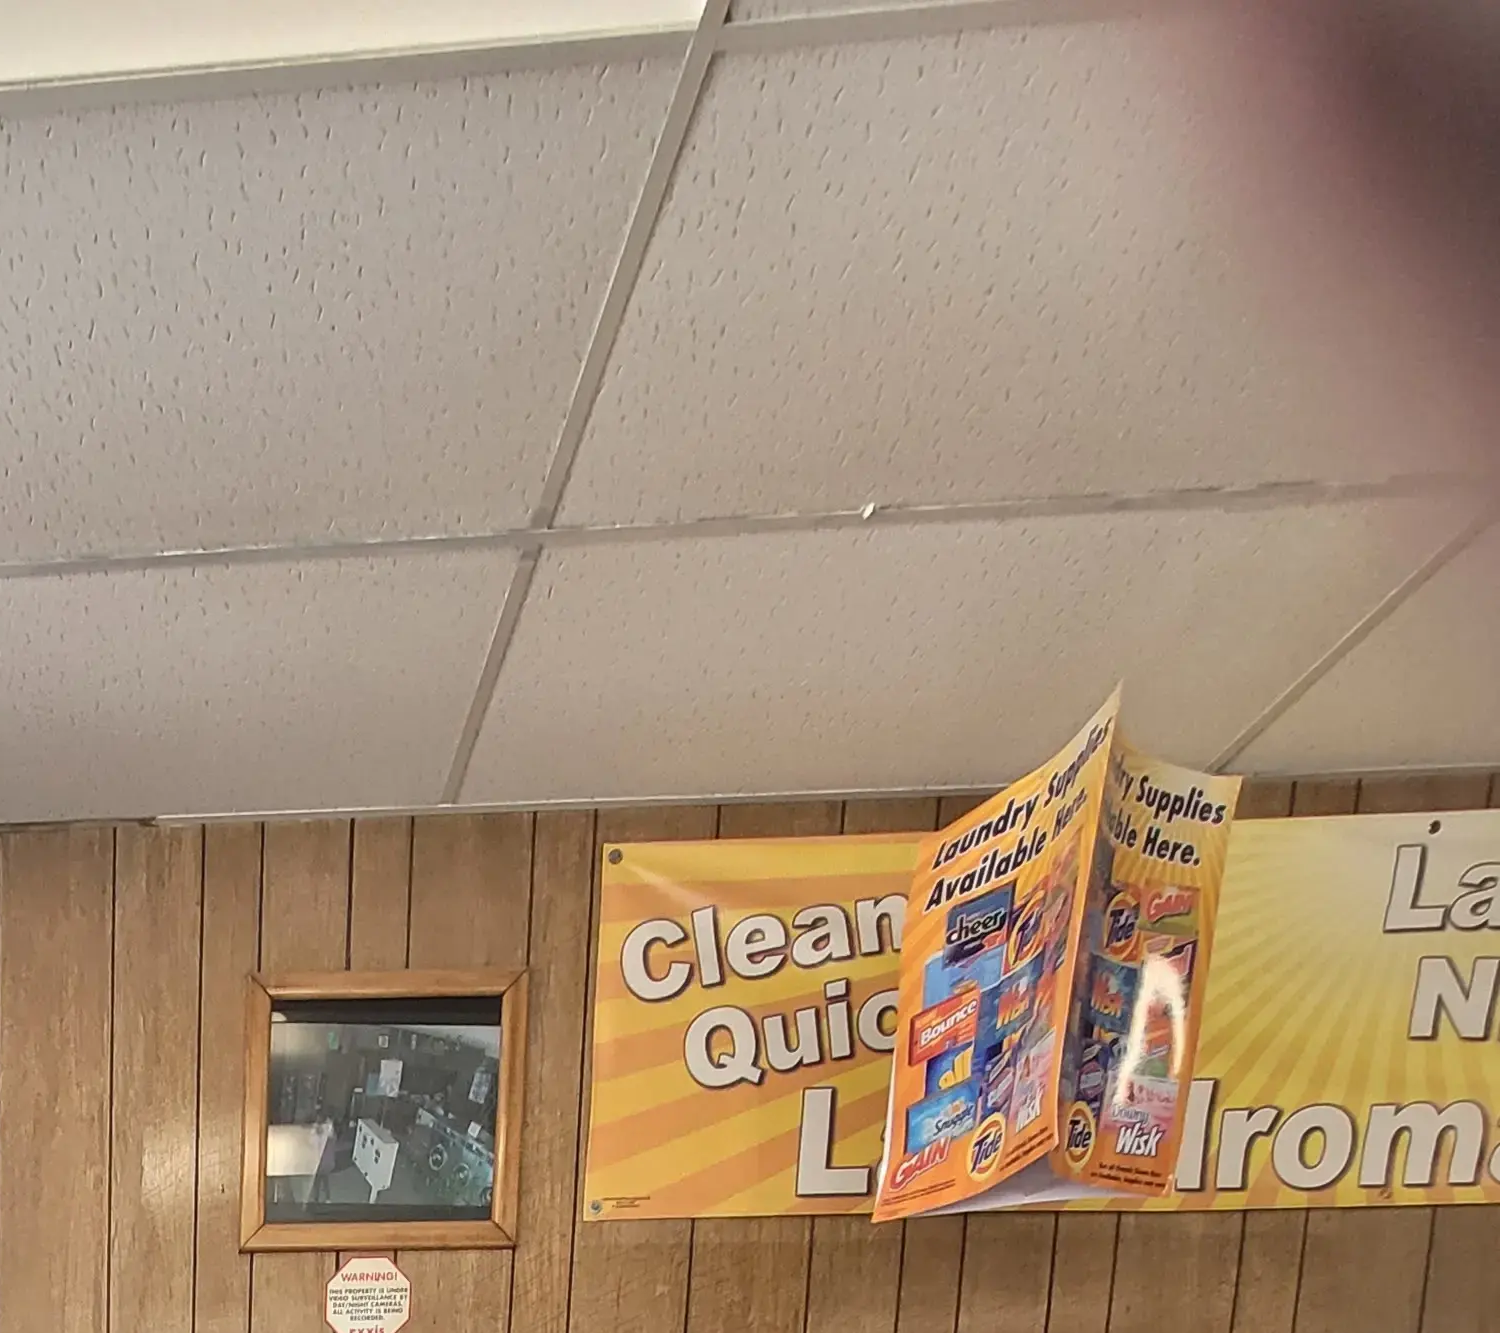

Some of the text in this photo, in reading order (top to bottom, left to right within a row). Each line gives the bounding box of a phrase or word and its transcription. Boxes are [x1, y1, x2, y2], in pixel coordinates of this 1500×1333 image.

[1136, 775, 1227, 826] Supplies
[932, 793, 1041, 871] Laundry
[1141, 826, 1202, 868] Here.
[922, 826, 1048, 914] Available
[1383, 844, 1500, 933] La
[946, 908, 1008, 946] cheer
[684, 977, 900, 1088] Quic
[920, 999, 979, 1048] Bounce
[938, 1045, 974, 1090] all
[971, 1132, 1003, 1175] Tide
[1067, 1118, 1092, 1151] Tide
[1115, 1122, 1165, 1157] Wisk
[341, 1272, 398, 1282] WARNING!
